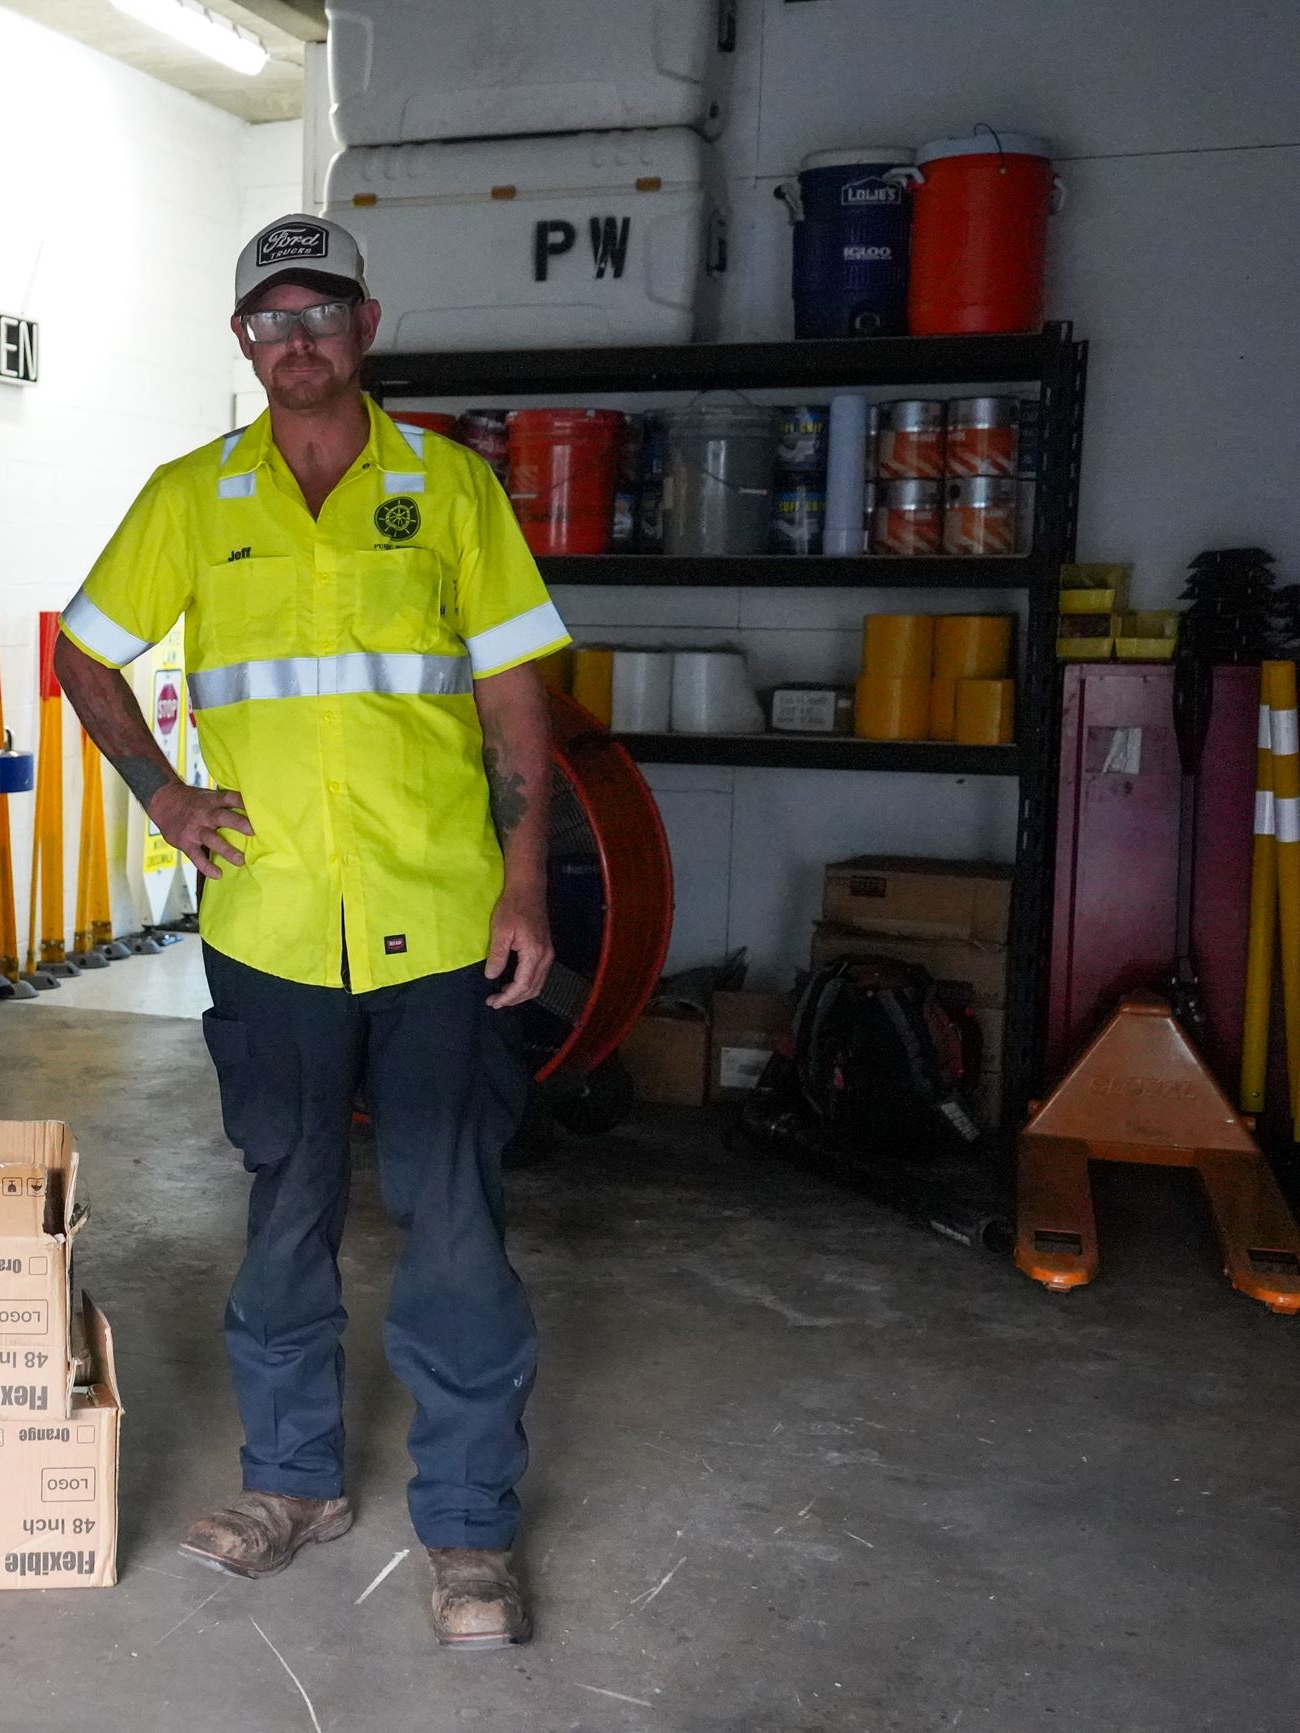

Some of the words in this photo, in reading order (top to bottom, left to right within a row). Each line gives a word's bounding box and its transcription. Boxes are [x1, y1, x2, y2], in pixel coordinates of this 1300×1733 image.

[263, 228, 320, 253] Ford
[534, 216, 631, 281] PW
[270, 247, 312, 260] TRUCKS
[227, 547, 252, 562] Jeff
[24, 1351, 49, 1369] 48
[18, 1427, 71, 1443] Orange
[46, 1478, 89, 1491] LOGO
[22, 1518, 66, 1536] Inch
[72, 1517, 96, 1535] 48
[4, 1550, 96, 1577] Flexible
